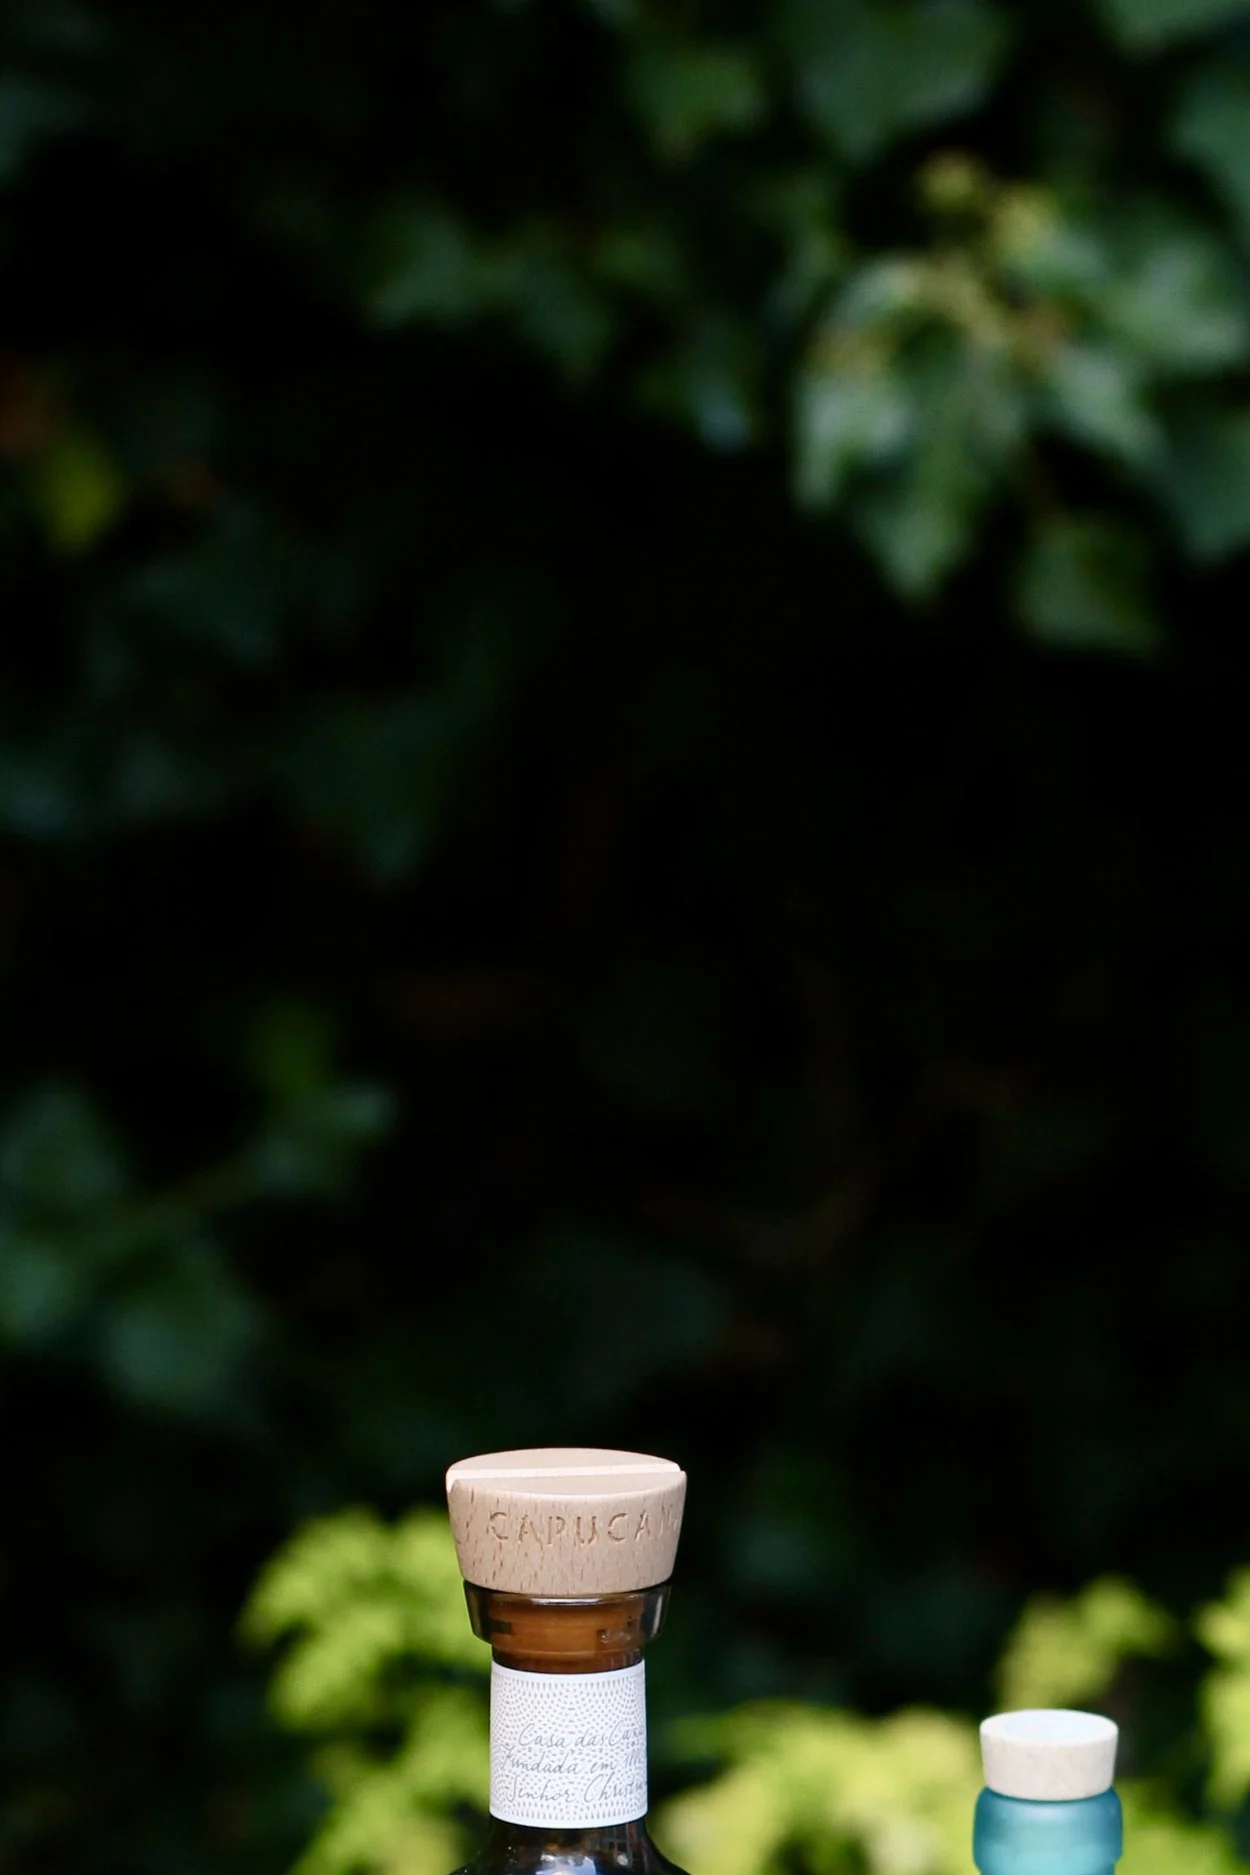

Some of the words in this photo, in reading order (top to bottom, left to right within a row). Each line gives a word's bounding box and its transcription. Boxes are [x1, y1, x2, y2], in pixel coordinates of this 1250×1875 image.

[518, 1722, 568, 1749] Casa
[574, 1726, 607, 1748] das
[506, 1773, 574, 1804] Senhor
